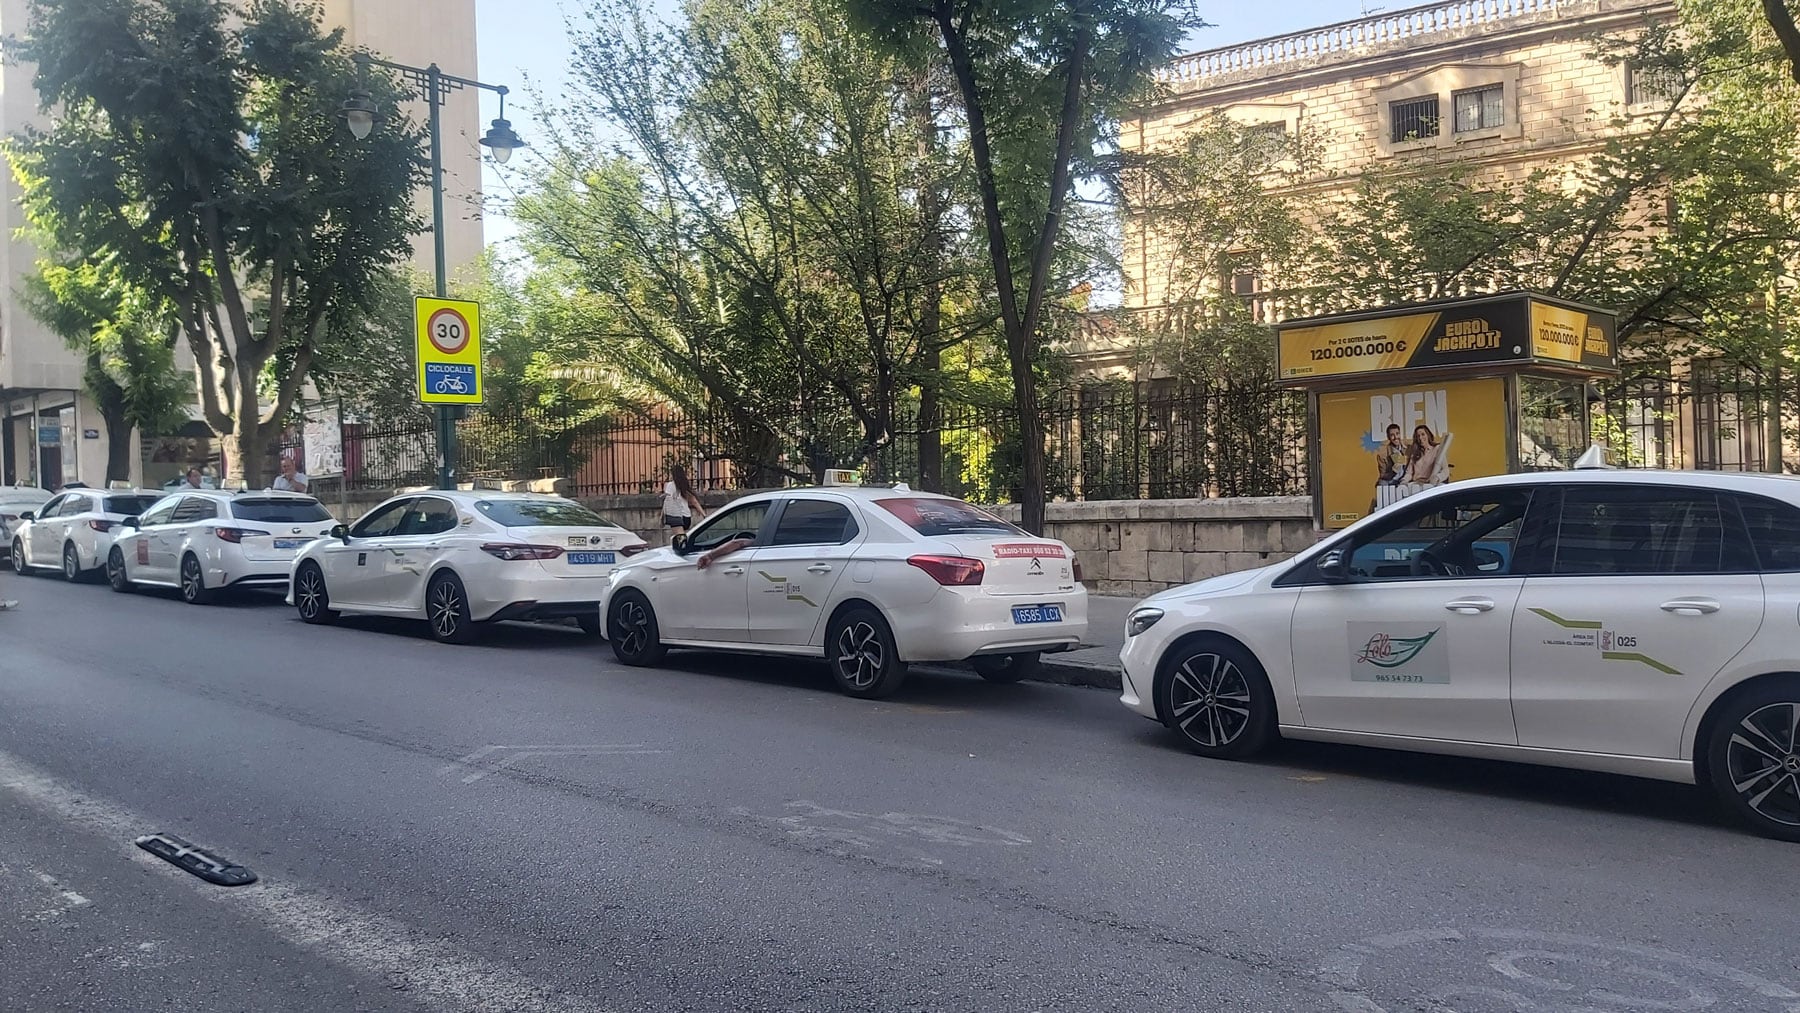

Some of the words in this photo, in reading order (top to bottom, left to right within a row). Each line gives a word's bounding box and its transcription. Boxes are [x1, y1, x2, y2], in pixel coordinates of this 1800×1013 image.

[437, 323, 460, 339] 30
[1445, 319, 1485, 337] EURO
[1433, 331, 1497, 352] JACKPOT
[1310, 341, 1394, 361] 120.000.000
[427, 364, 473, 374] CICLOCALLE
[1370, 389, 1448, 442] BIEN
[1020, 609, 1042, 621] 6585
[1043, 608, 1060, 621] LCX
[1617, 636, 1637, 647] 025
